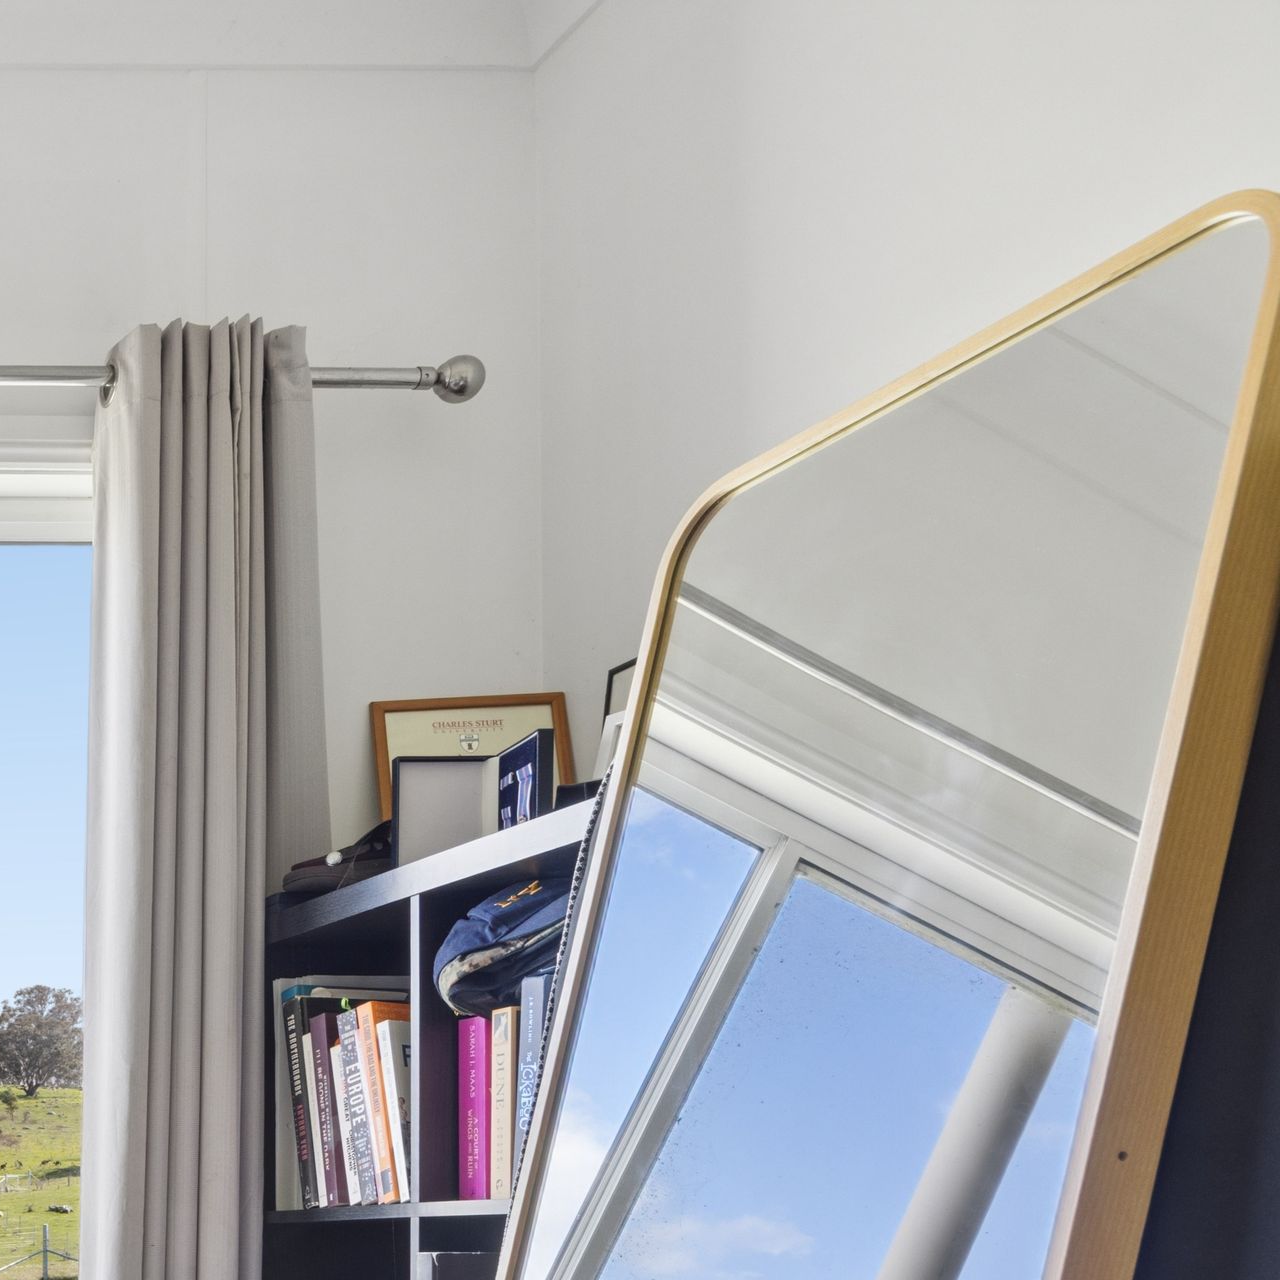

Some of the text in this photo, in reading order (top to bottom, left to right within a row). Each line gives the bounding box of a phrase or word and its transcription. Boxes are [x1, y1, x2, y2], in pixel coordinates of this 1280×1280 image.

[432, 719, 504, 729] CHARLES STURT
[317, 1081, 325, 1109] GONE
[346, 1062, 366, 1126] EUROPE
[495, 1052, 505, 1110] DUNE
[320, 1111, 326, 1122] IN
